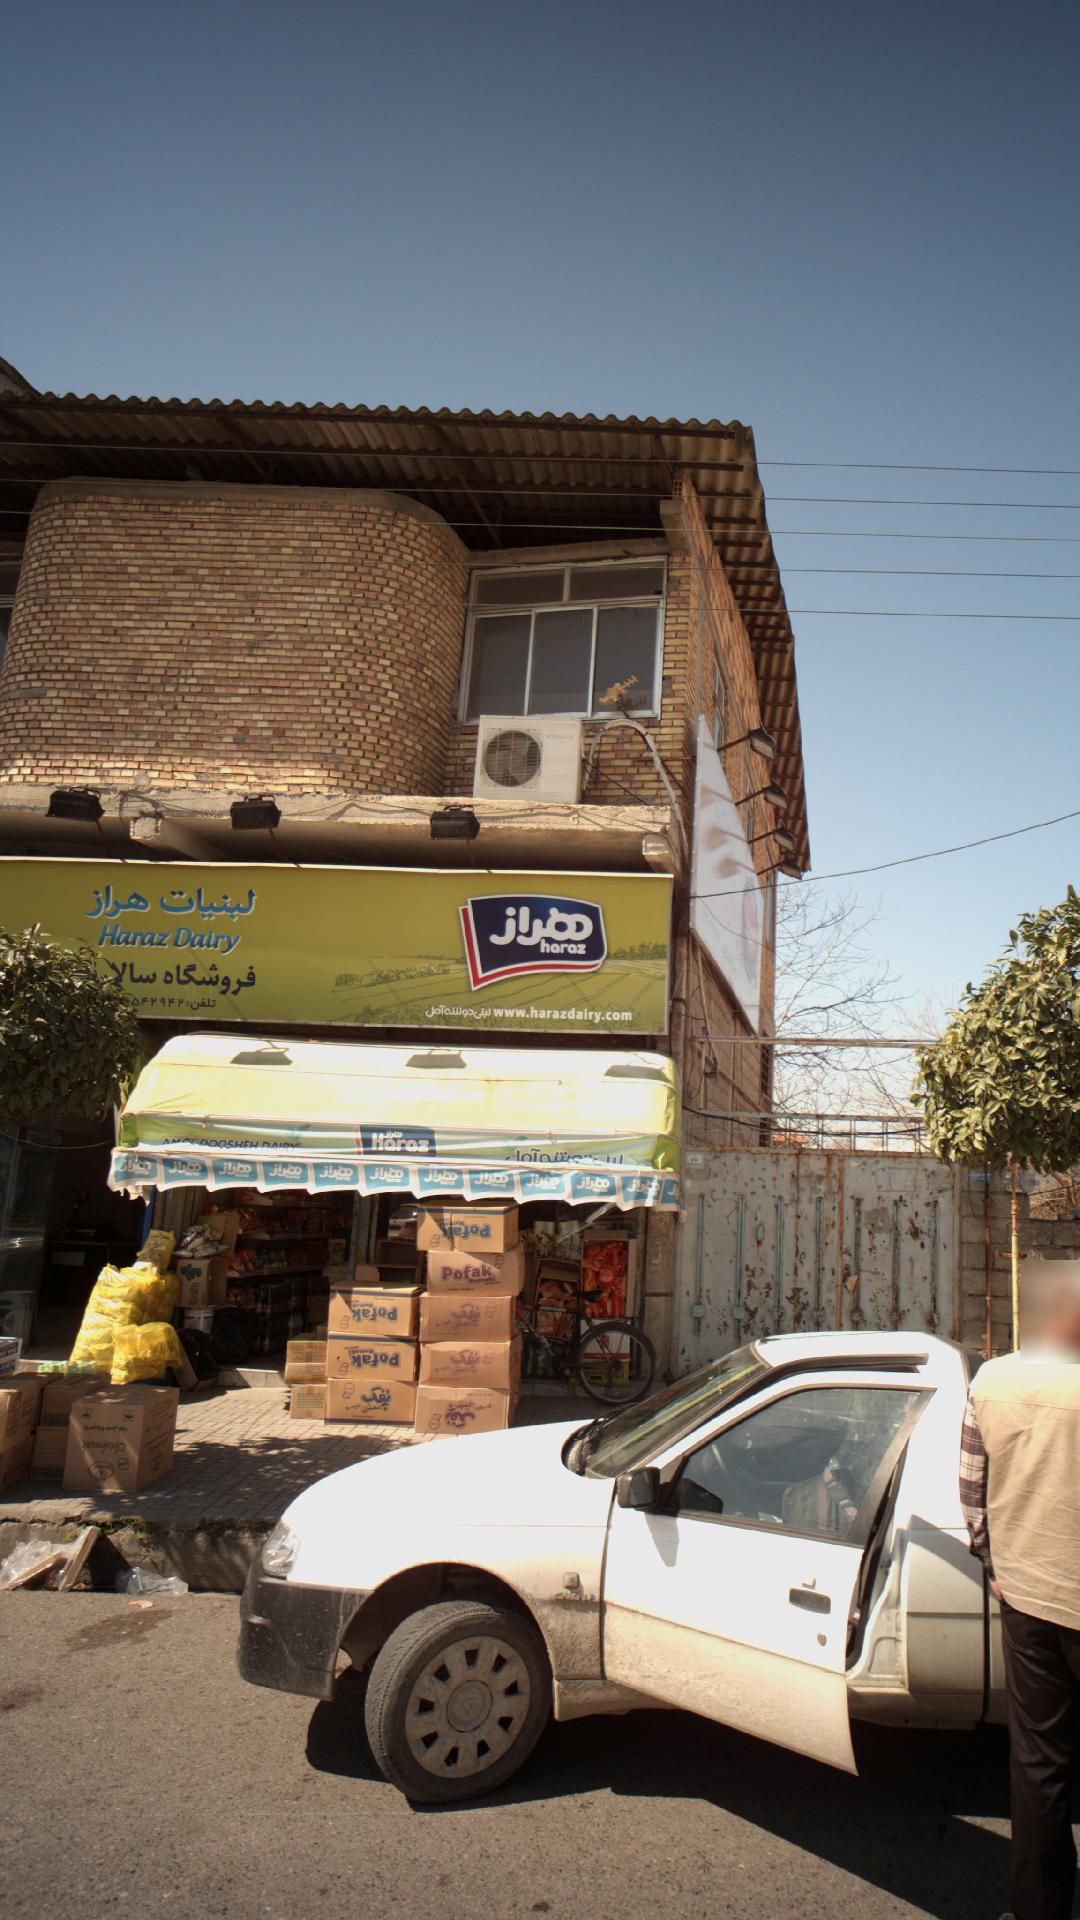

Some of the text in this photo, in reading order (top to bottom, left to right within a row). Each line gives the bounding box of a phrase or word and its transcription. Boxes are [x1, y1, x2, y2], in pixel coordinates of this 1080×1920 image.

[84, 884, 256, 921] لبنیات هراز
[489, 906, 593, 946] هراز
[98, 923, 240, 955] Haraz Dairy
[540, 939, 587, 955] haraz
[106, 961, 257, 995] فروشگاه سالا
[493, 1007, 632, 1023] www.harazdairy.com
[441, 1264, 492, 1281] Pofak
[352, 1307, 399, 1323] Pofak
[351, 1353, 400, 1369] Pofak
